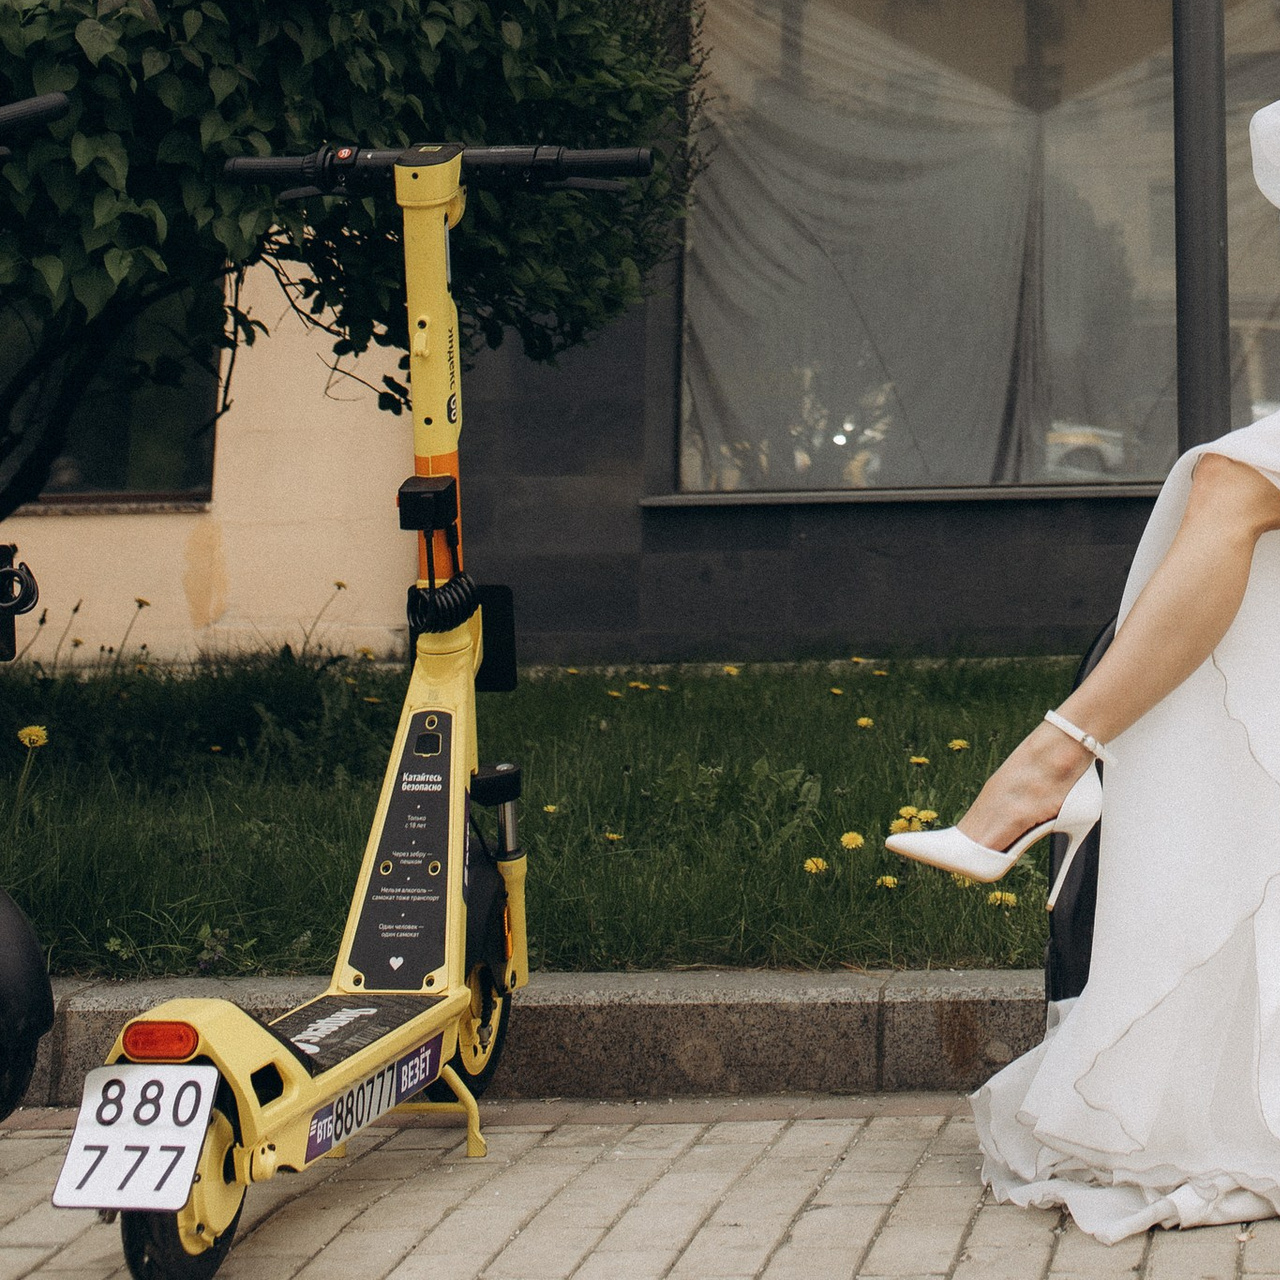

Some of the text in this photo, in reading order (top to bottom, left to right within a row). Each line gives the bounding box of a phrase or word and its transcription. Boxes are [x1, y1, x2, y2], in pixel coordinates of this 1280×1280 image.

[402, 782, 442, 791] безопасно
[403, 772, 442, 781] Катайтесь
[95, 1078, 201, 1127] 880
[317, 1046, 432, 1143] ВТБ 880777 ВЕЗЁТ
[75, 1145, 185, 1192] 777
